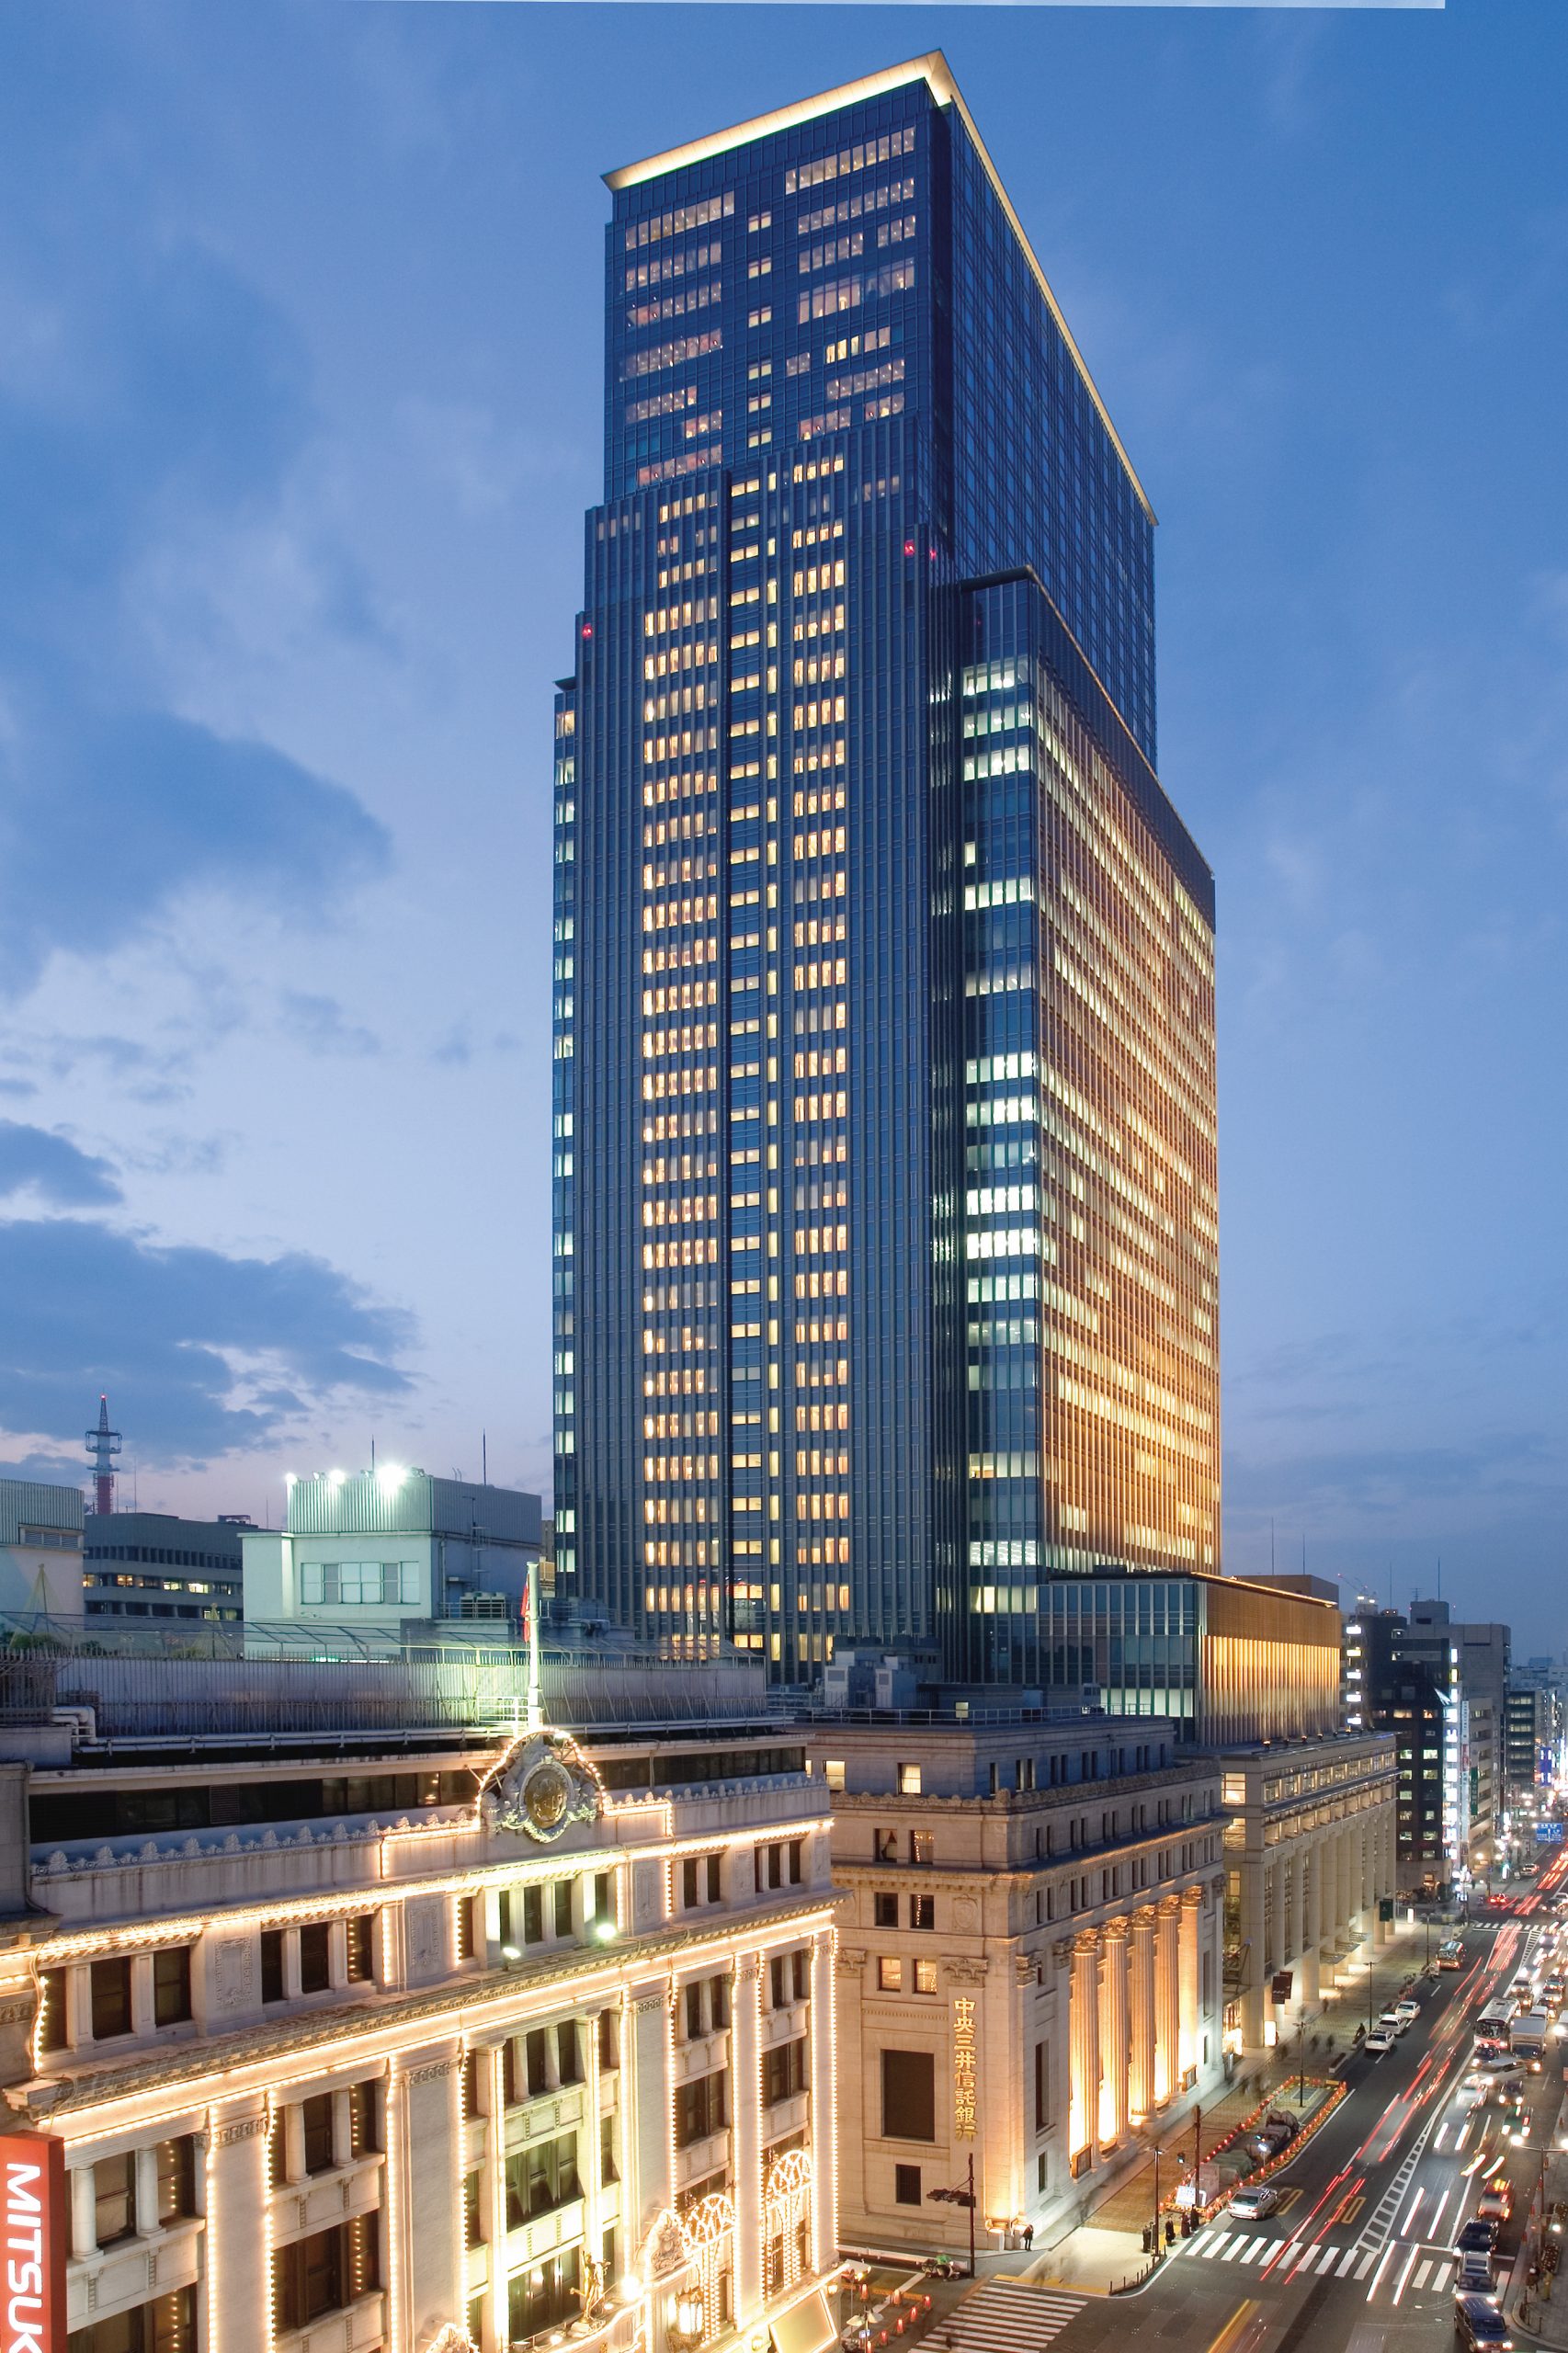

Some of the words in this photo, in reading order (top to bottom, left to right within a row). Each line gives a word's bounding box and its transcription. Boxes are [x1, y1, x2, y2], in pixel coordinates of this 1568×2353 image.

[953, 1997, 978, 2143] 中央三井信託銀行
